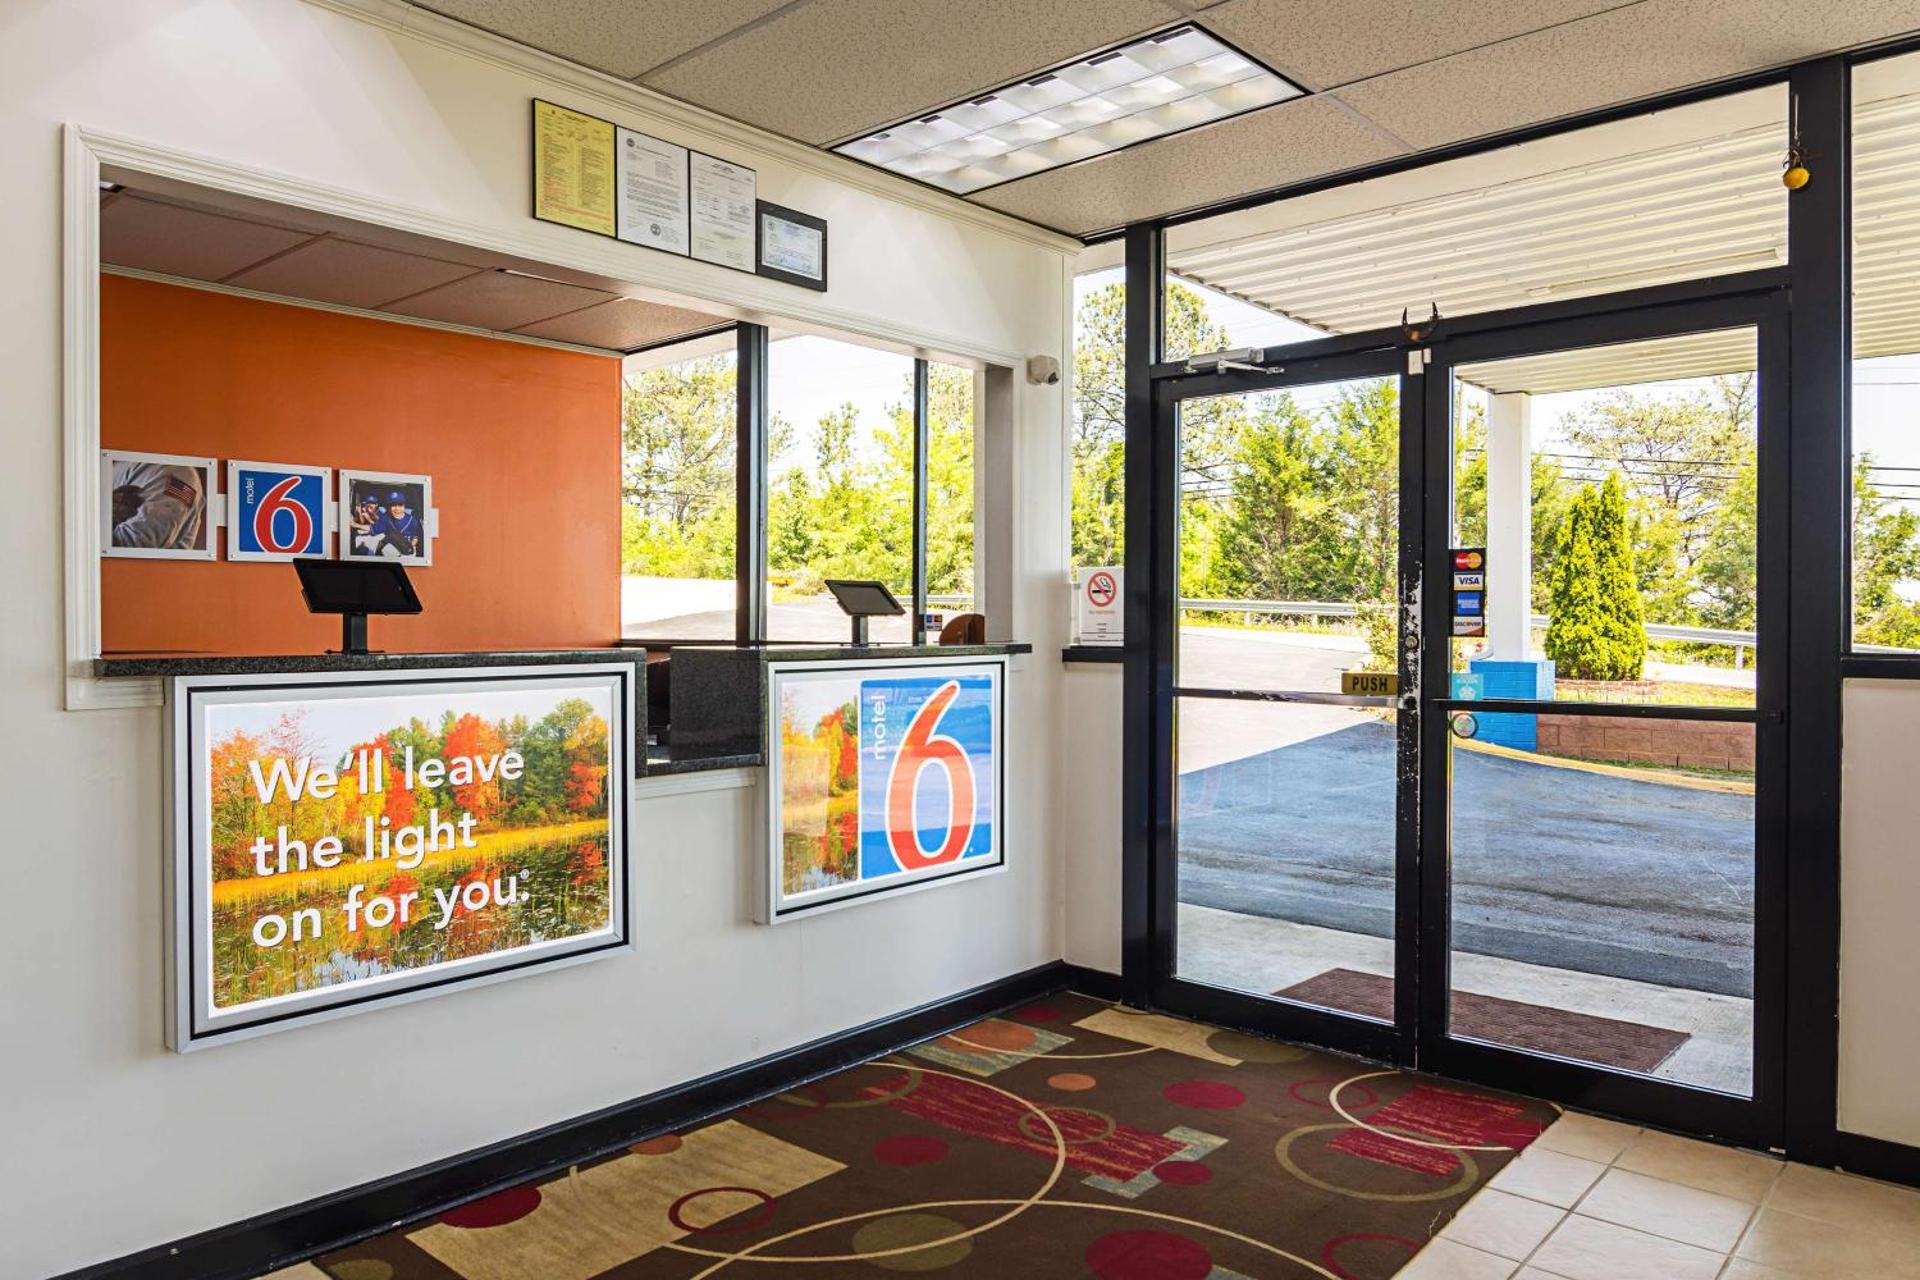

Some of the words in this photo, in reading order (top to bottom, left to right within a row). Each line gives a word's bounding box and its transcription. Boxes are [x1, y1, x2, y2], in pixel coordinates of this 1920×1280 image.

[245, 477, 255, 504] motel
[253, 475, 313, 555] 6
[1458, 576, 1480, 585] VISA
[1352, 676, 1388, 692] PUSH
[249, 747, 384, 804] We'll
[404, 745, 525, 791] leave
[872, 695, 887, 760] motel
[885, 680, 977, 872] 6
[249, 824, 342, 876] the
[364, 808, 477, 869] light
[251, 908, 322, 948] on
[343, 883, 421, 933] for
